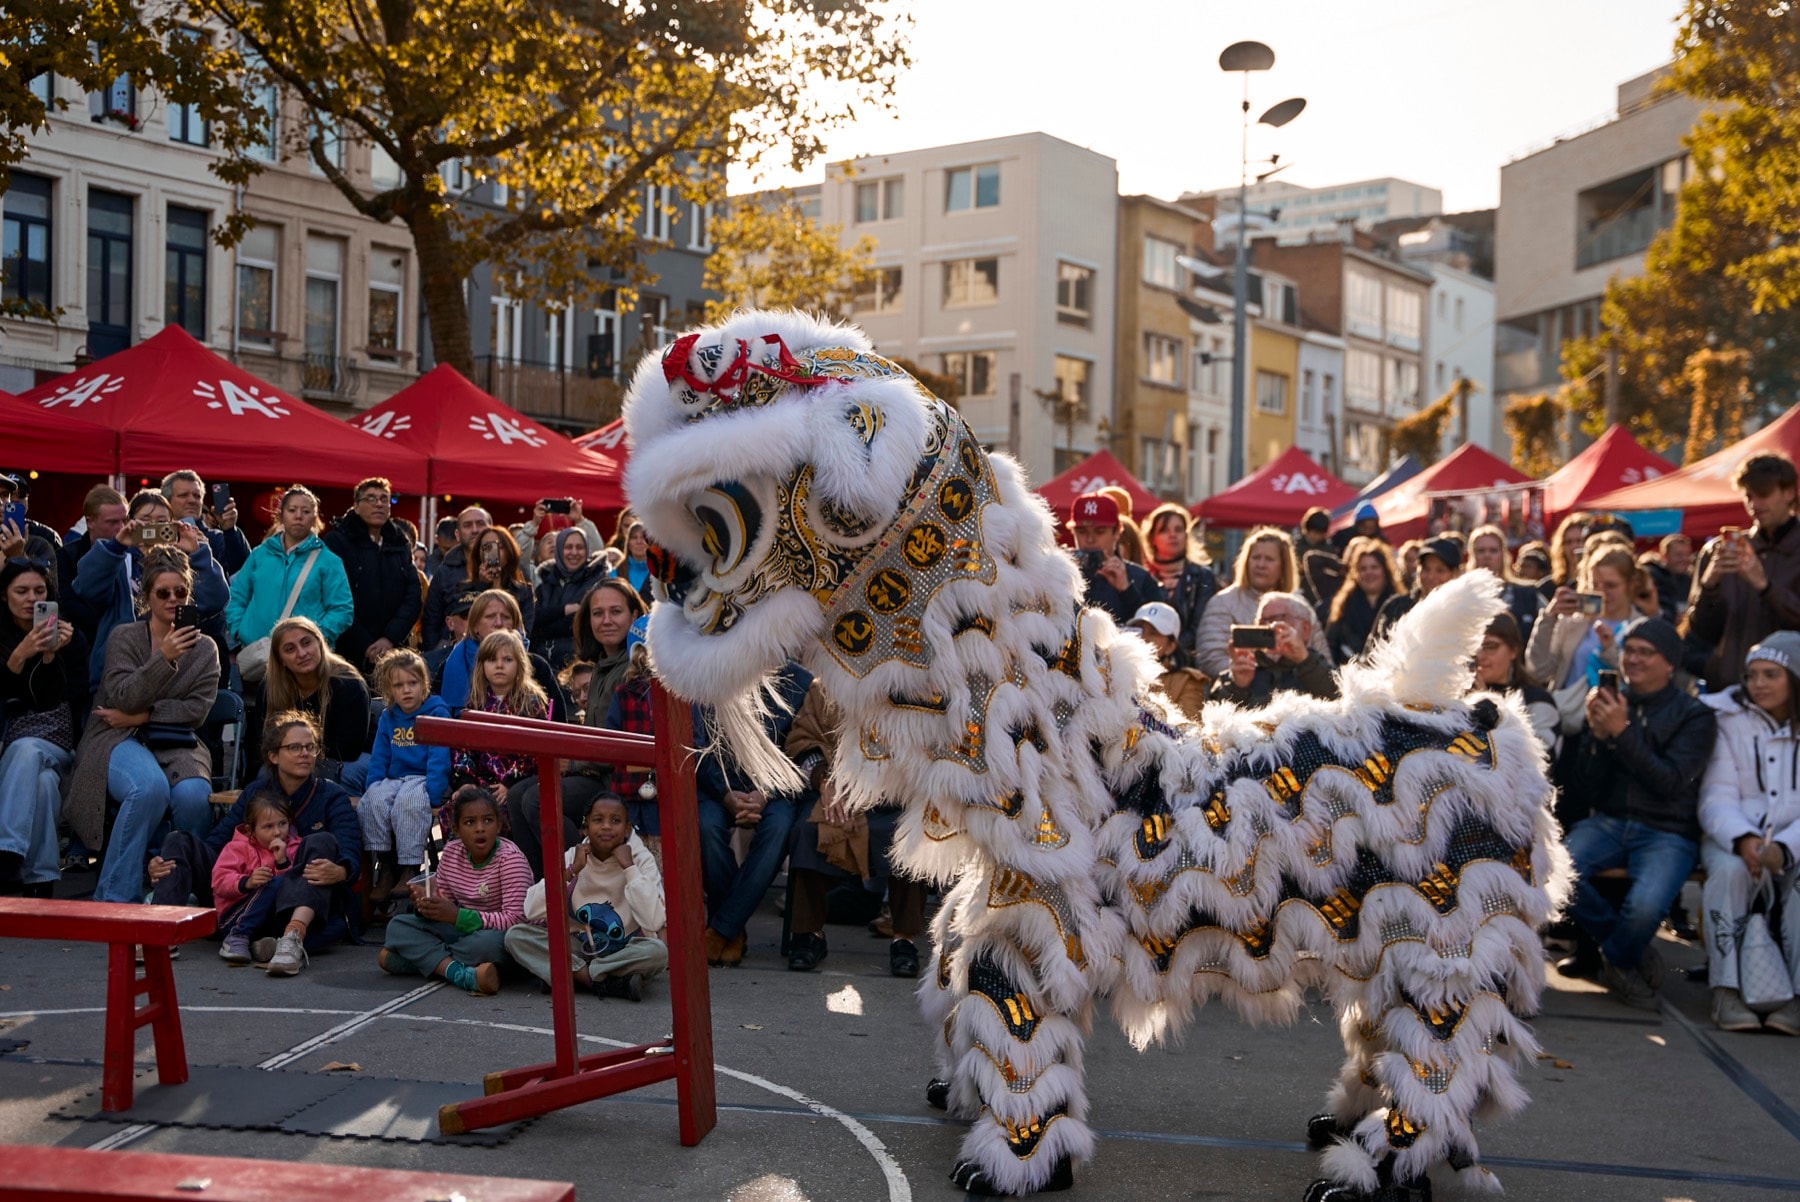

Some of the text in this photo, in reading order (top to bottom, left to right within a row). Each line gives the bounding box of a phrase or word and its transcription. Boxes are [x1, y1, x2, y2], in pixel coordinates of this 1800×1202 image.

[219, 380, 280, 418] A
[487, 413, 541, 447] A
[1284, 472, 1316, 495] A
[392, 727, 414, 740] 206
